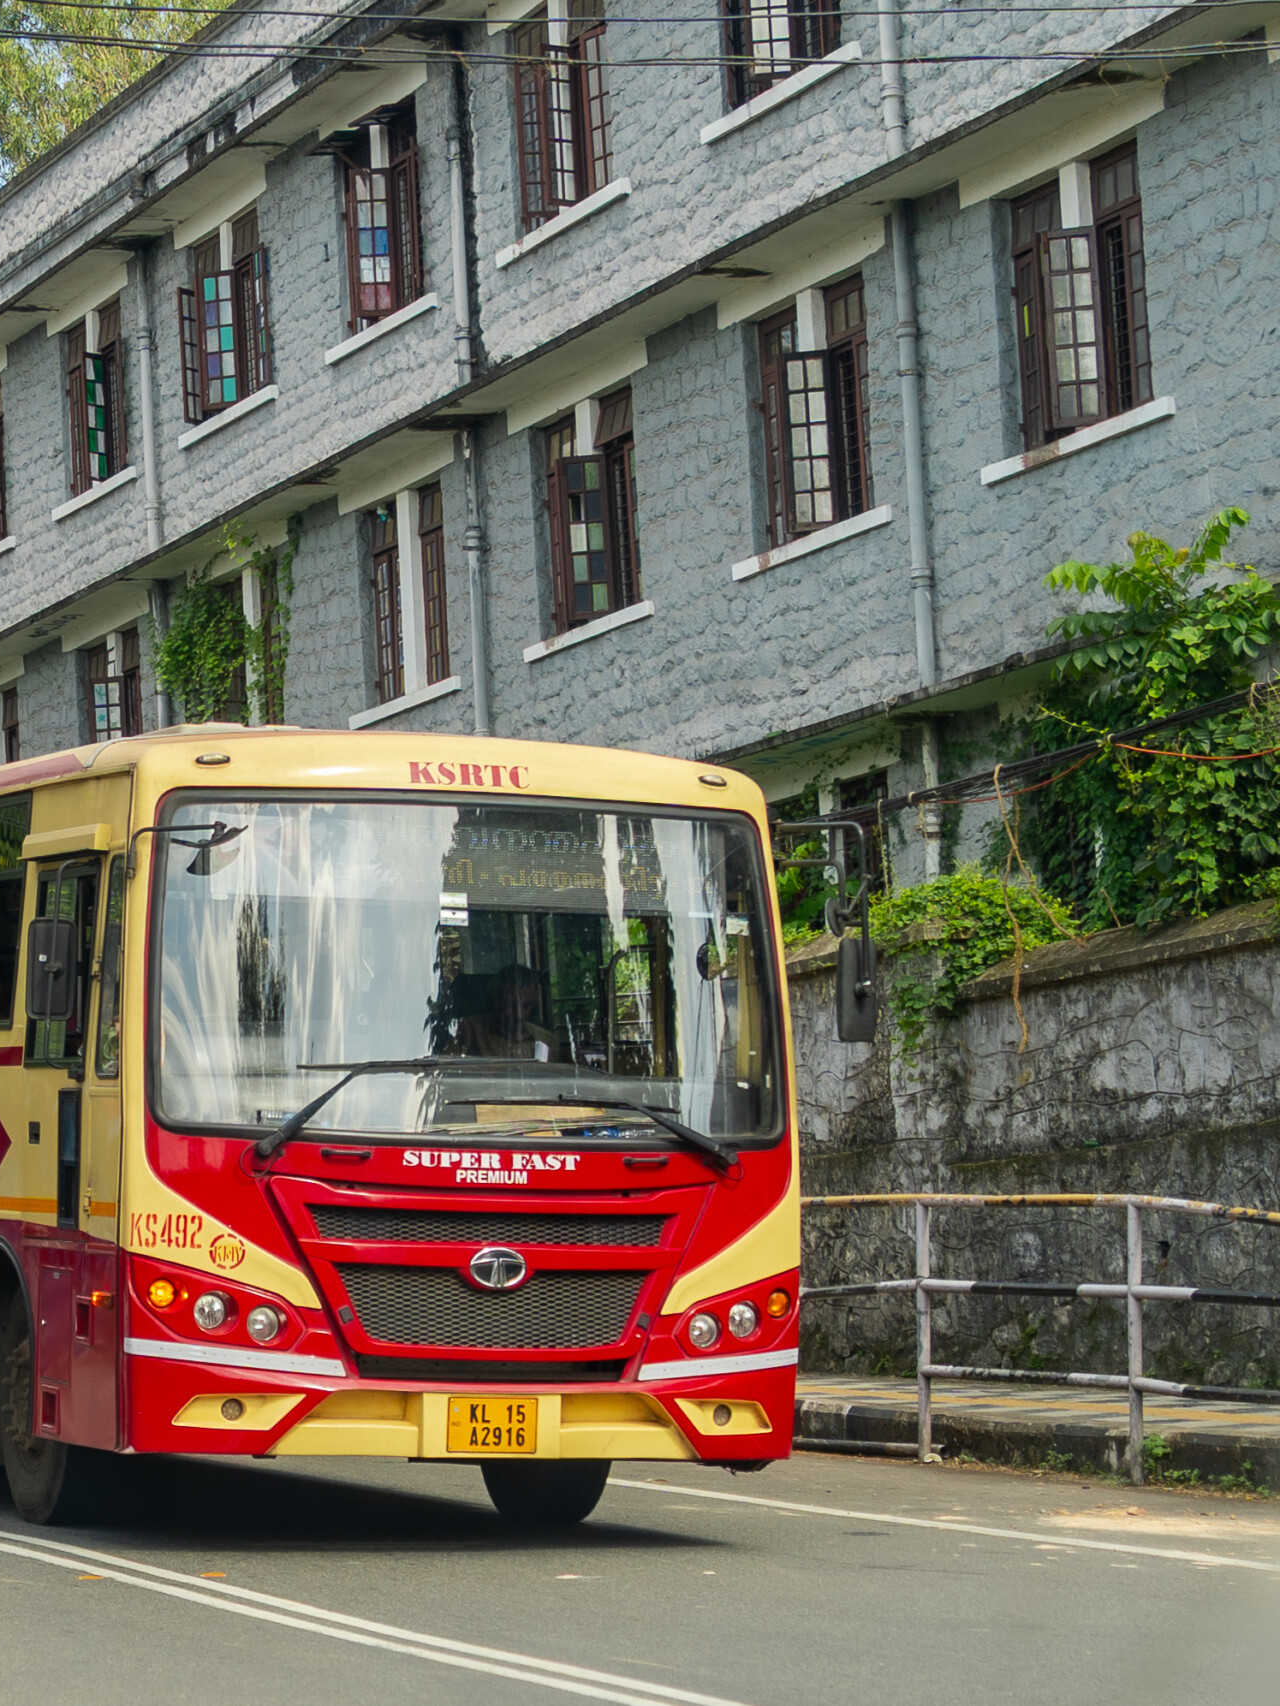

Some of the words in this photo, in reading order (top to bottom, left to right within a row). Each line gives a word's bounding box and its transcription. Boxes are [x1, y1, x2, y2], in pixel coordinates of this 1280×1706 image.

[410, 760, 531, 790] KSRTC
[402, 1150, 501, 1169] SUPER
[511, 1153, 581, 1171] FAST
[455, 1169, 528, 1184] PREMIUM
[130, 1212, 204, 1249] KS492
[469, 1403, 491, 1424] KL
[506, 1404, 526, 1425] 15
[469, 1426, 526, 1448] A2916
